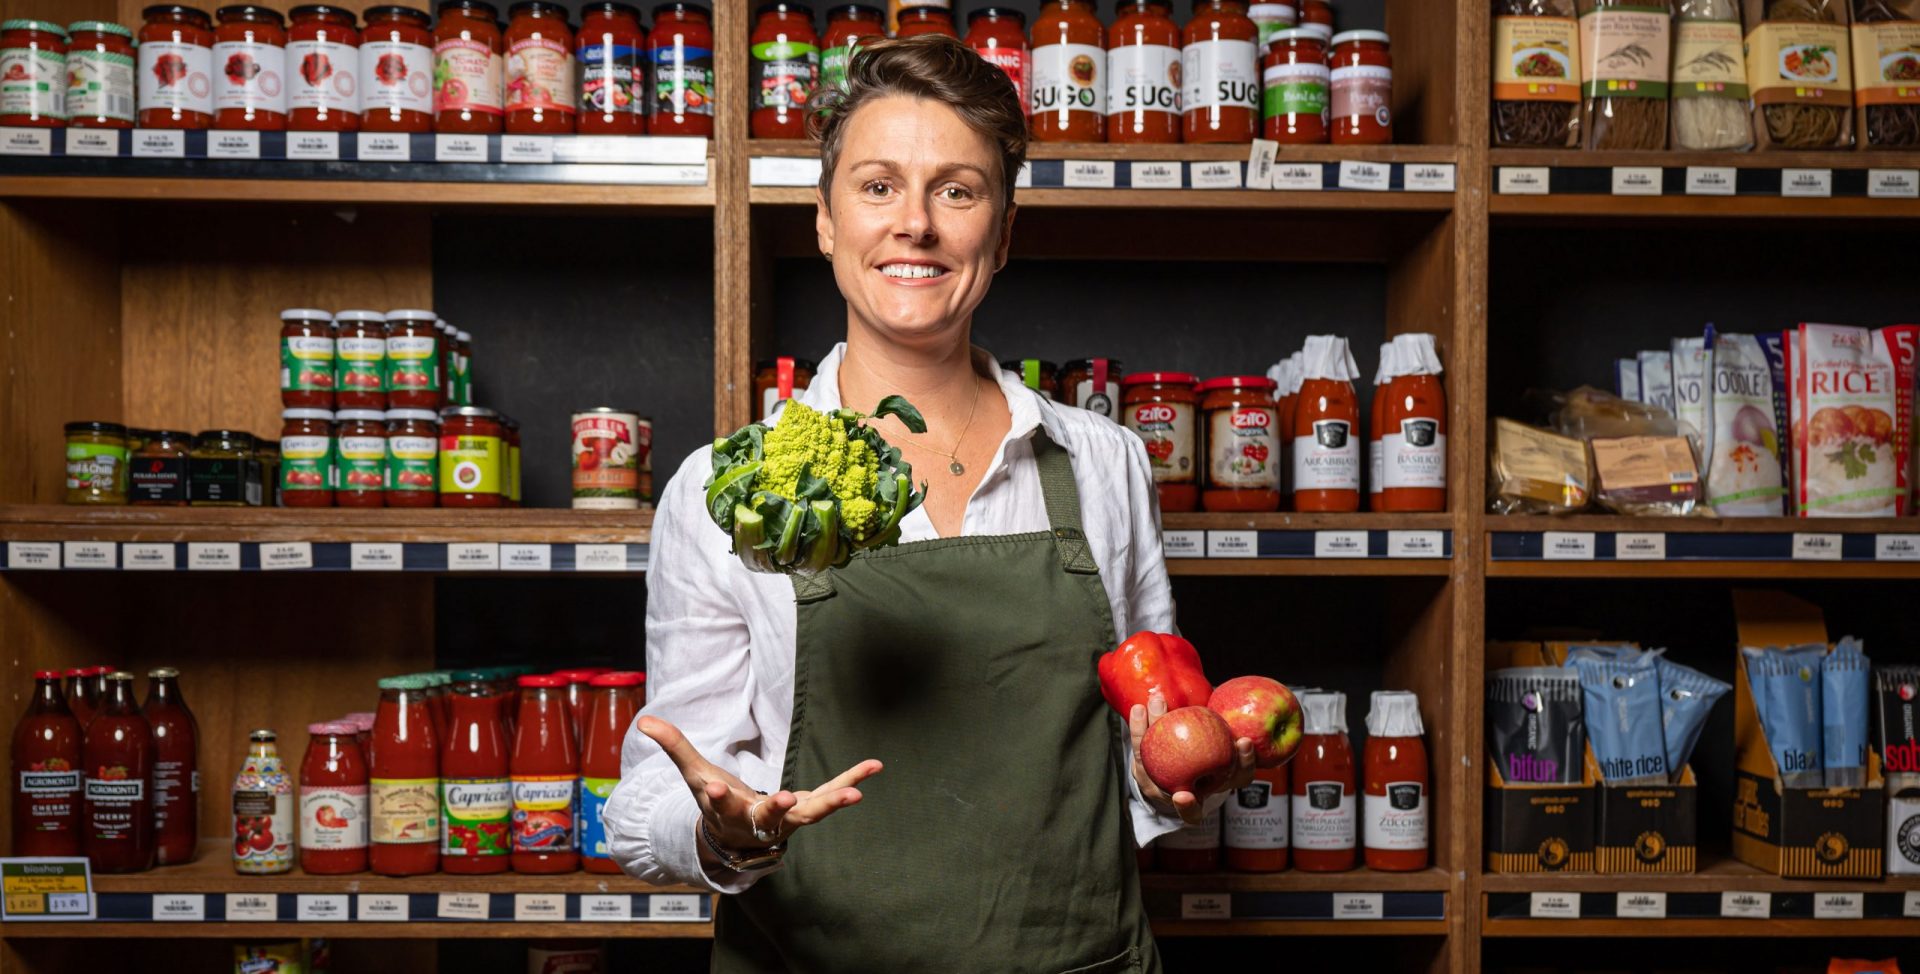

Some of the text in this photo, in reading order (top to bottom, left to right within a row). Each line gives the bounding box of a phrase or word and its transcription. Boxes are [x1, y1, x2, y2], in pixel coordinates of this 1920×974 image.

[1033, 86, 1095, 109] SUGO
[1219, 82, 1258, 105] SUG
[1895, 331, 1915, 364] 5
[1811, 371, 1881, 395] RICE
[1636, 755, 1662, 775] rice
[1784, 749, 1817, 771] bla
[1886, 737, 1920, 772] sob
[1510, 752, 1557, 782] bifun
[26, 775, 75, 787] AGROMONTE
[514, 783, 569, 802] Capriccio
[93, 812, 131, 821] CHERRY
[23, 864, 64, 874] bioshop
